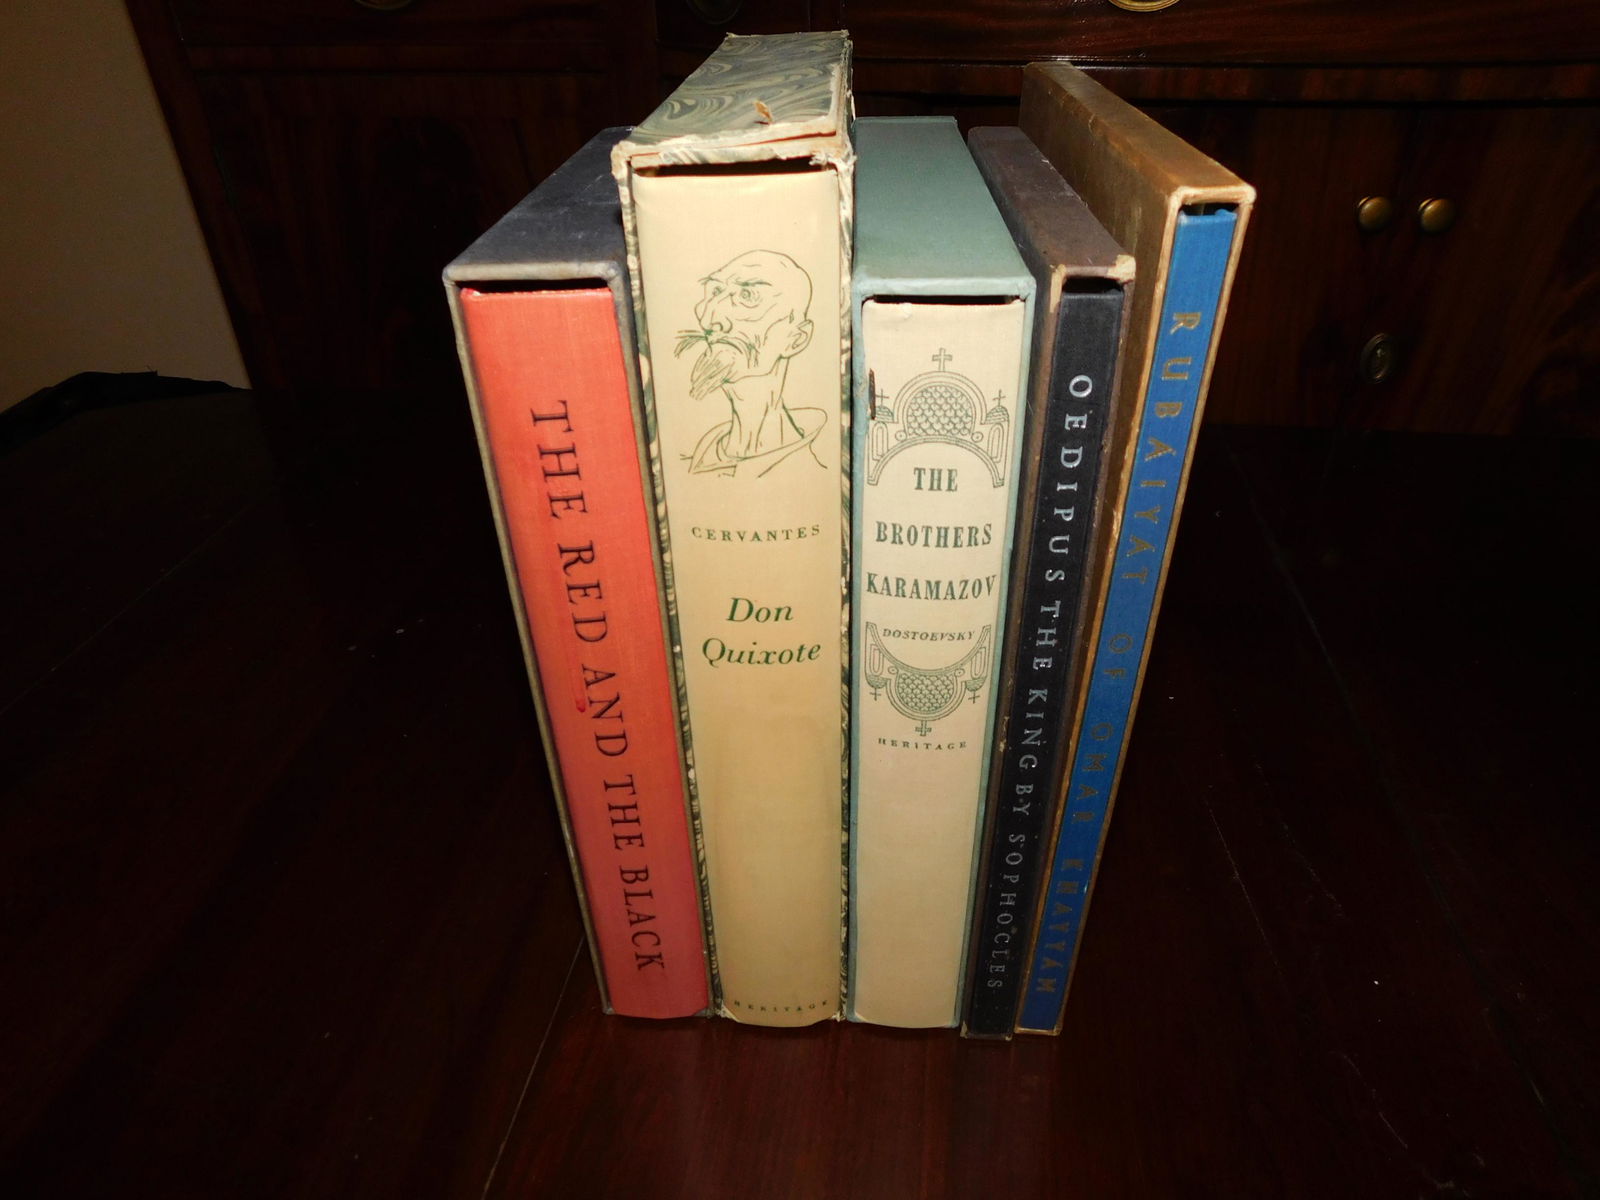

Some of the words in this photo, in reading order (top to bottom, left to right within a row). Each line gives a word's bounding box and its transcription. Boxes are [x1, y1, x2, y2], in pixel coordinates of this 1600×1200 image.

[530, 400, 588, 519] THE
[1121, 311, 1202, 584] RUBAIYAT
[914, 467, 958, 492] THE
[1045, 374, 1093, 582] OEDIPUS
[691, 524, 820, 542] CERVANTES
[876, 521, 992, 548] BROTHERS
[557, 540, 609, 642] RED
[726, 597, 794, 623] Don
[866, 572, 997, 600] KARAMAZOV
[702, 638, 821, 668] Quixote
[882, 628, 975, 641] DOSTOEVSKY
[1033, 600, 1061, 670] THE
[1103, 633, 1134, 679] OF
[581, 664, 629, 757] AND
[1019, 688, 1048, 770] KING
[878, 738, 967, 750] HERITAGE
[603, 774, 645, 851] THE
[1013, 783, 1034, 816] BY
[619, 864, 665, 971] BLACK
[987, 833, 1025, 988] SOPHOCLES
